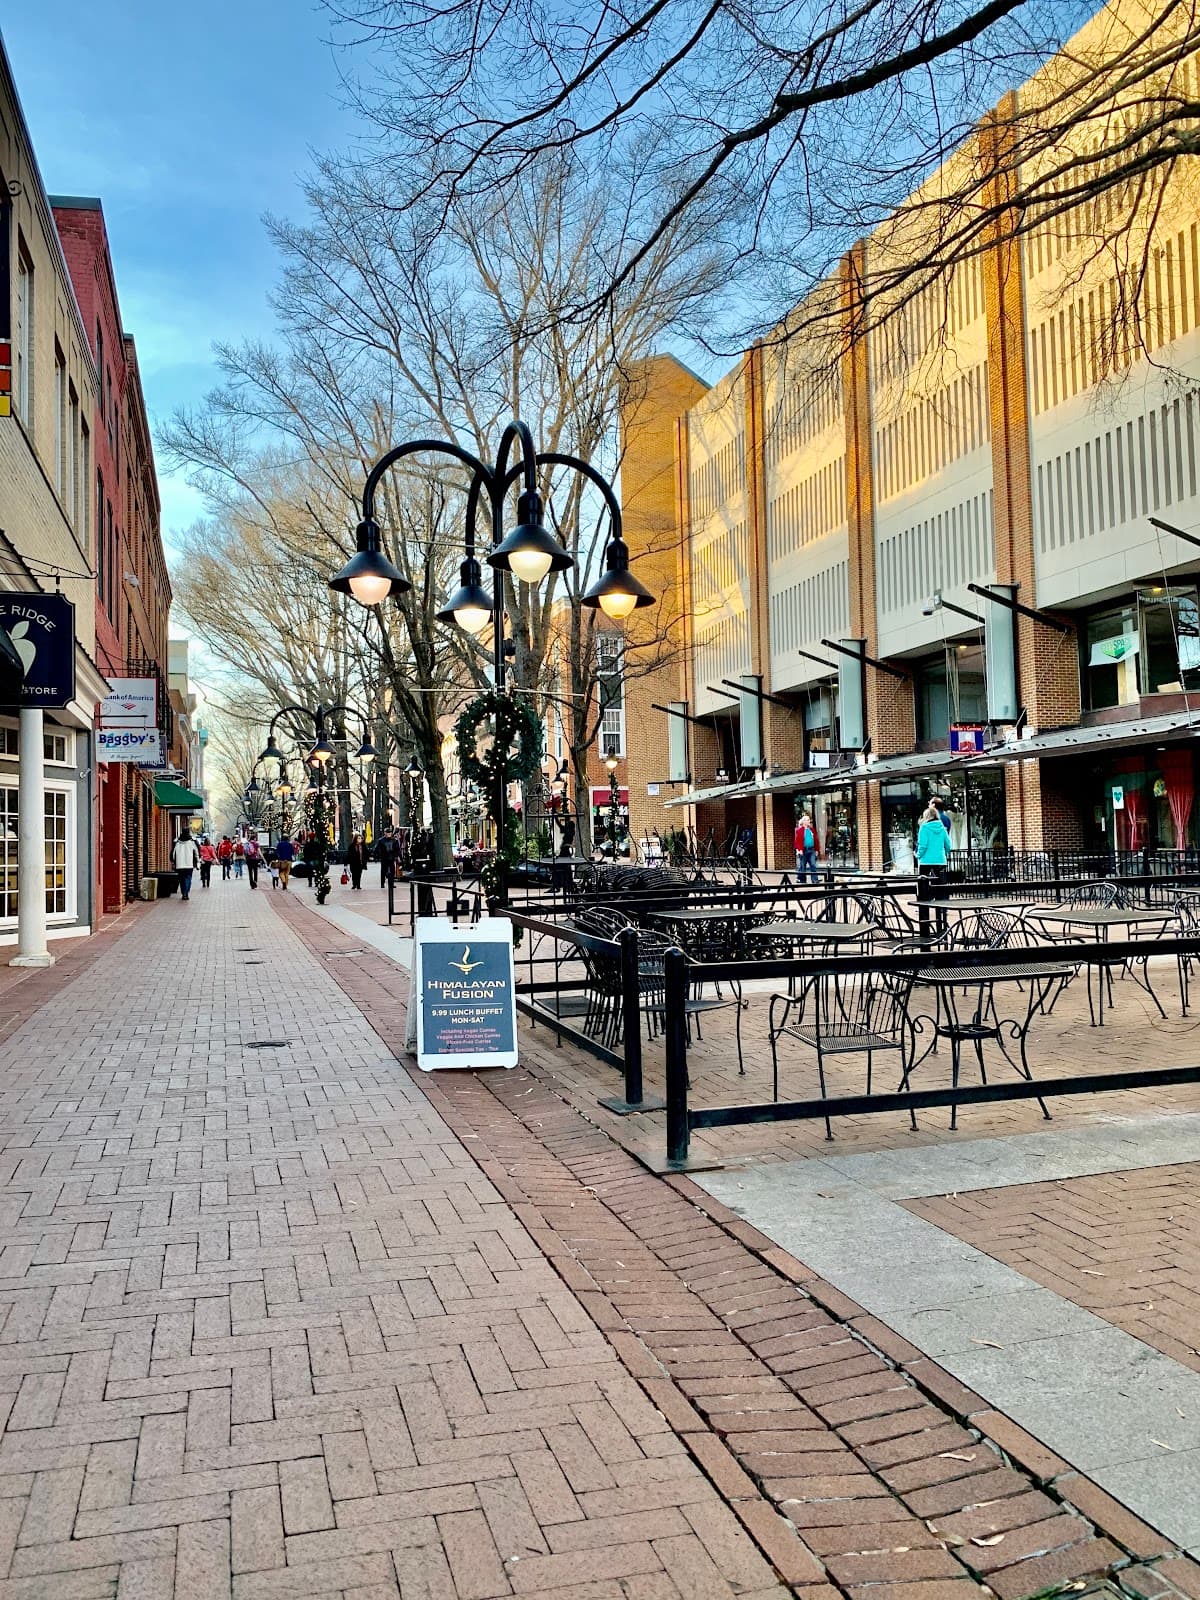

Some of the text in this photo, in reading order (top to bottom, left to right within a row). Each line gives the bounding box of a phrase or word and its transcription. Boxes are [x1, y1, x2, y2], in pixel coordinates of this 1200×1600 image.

[11, 605, 57, 632] RIDGE
[128, 694, 154, 702] America
[98, 733, 156, 746] Baggby's
[428, 980, 506, 989] HIMALAYAN
[442, 990, 494, 999] FUSION
[431, 1007, 504, 1017] 9.99 LUNCH BUFFET
